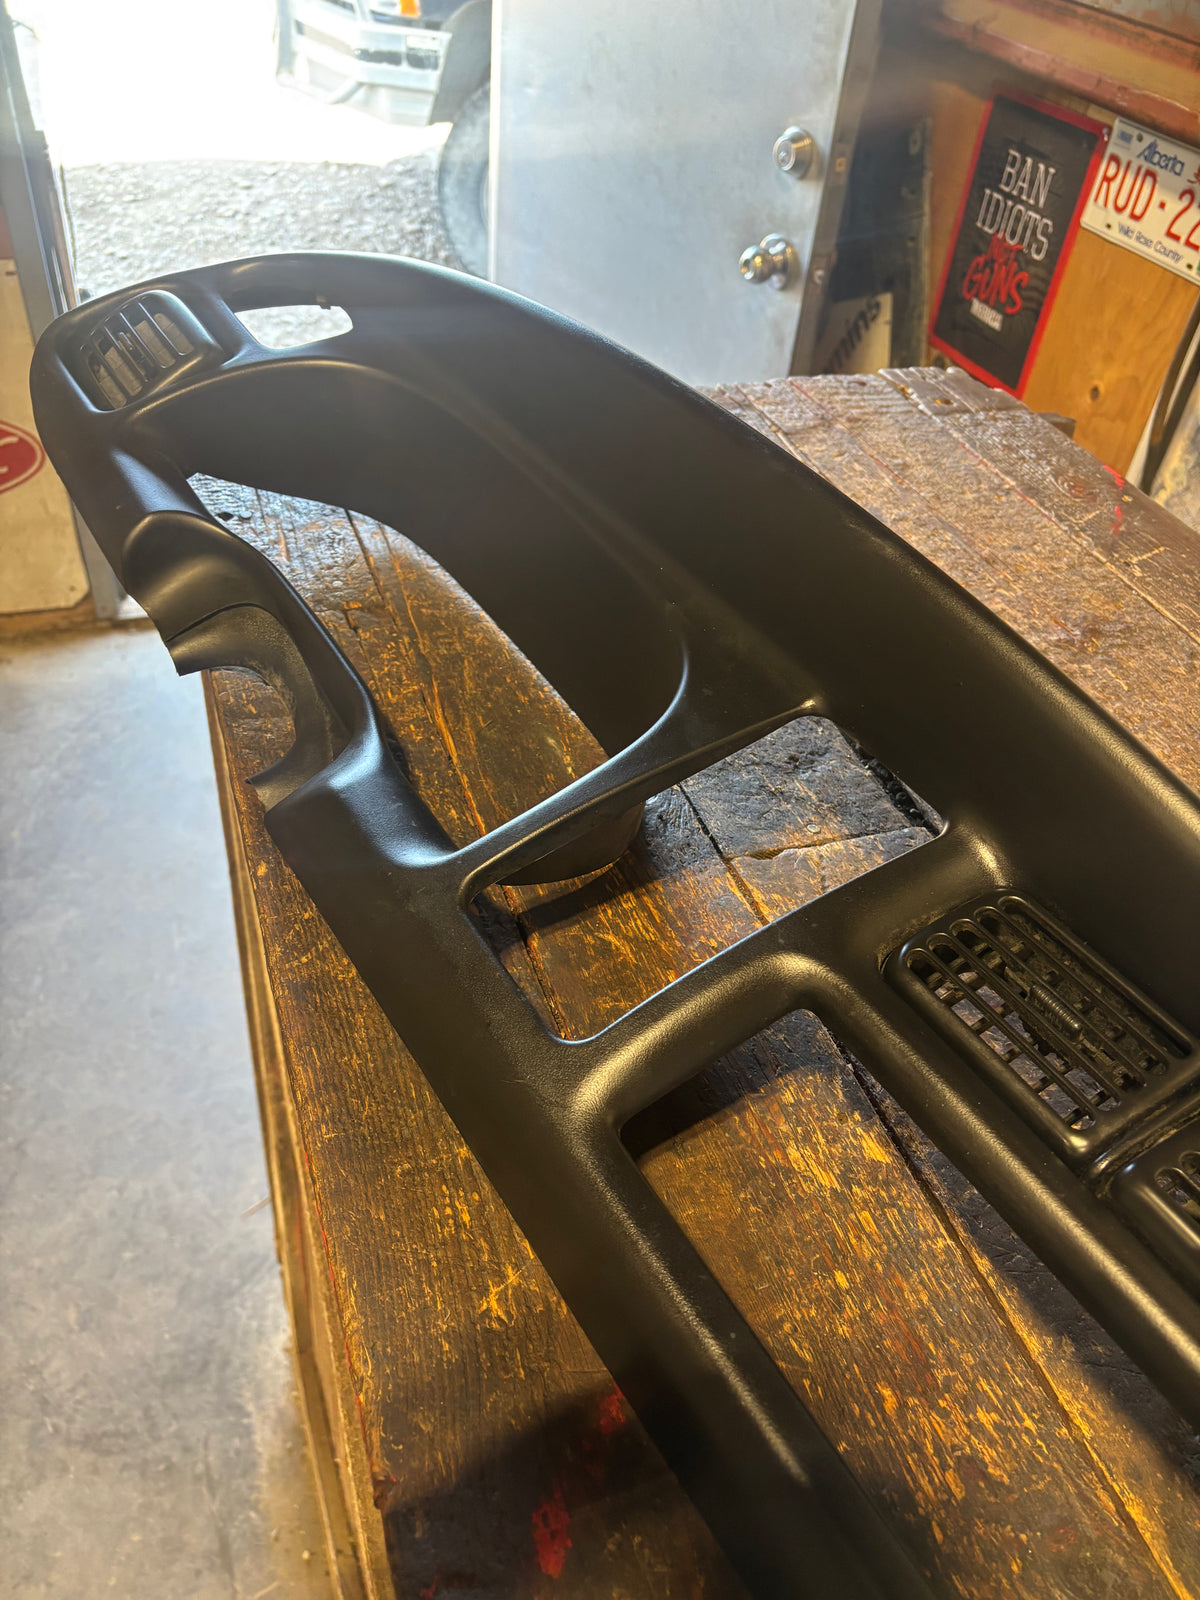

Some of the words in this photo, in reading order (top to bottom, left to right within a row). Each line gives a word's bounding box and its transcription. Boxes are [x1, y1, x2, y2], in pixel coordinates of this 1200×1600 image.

[998, 149, 1056, 209] BAN
[1137, 139, 1185, 176] Alberta
[975, 188, 1054, 261] IDIOTS
[1153, 239, 1184, 263] County
[962, 254, 1030, 314] GUNS
